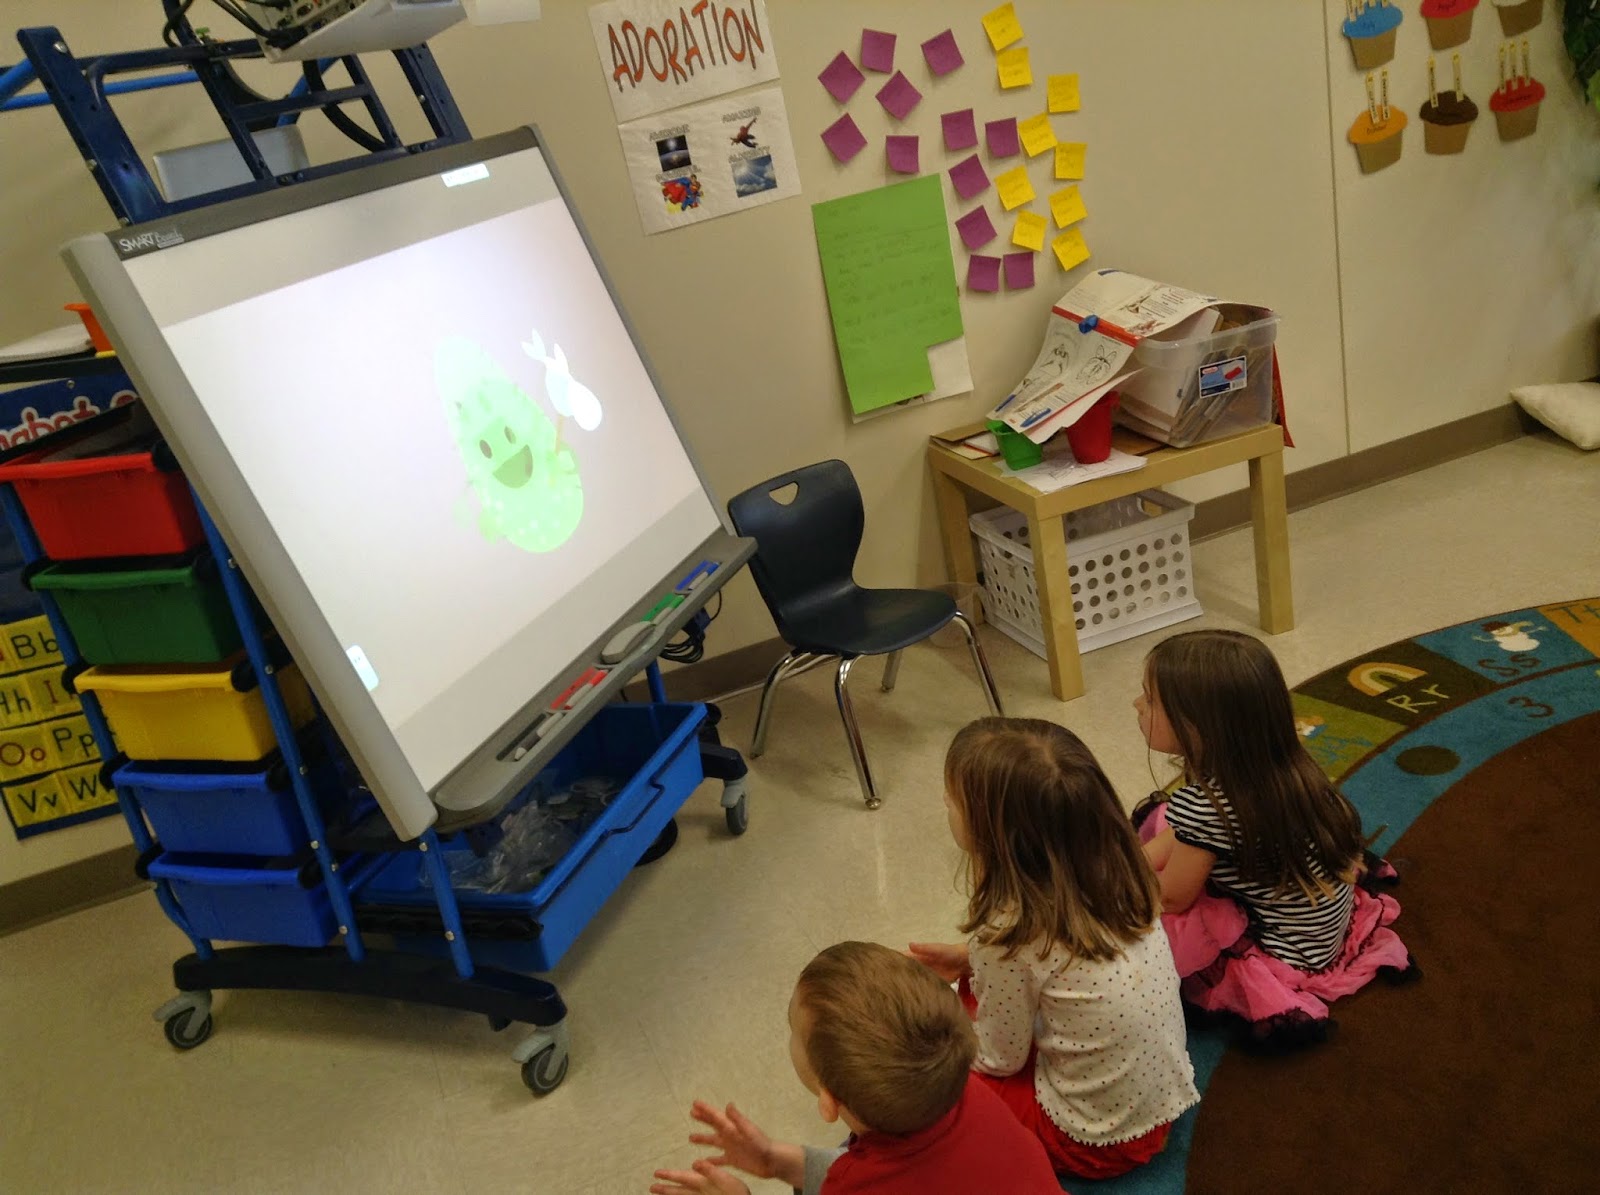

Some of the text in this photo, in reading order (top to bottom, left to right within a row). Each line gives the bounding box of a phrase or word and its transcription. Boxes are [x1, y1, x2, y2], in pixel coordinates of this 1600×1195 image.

[607, 0, 765, 93] ADORATION
[119, 232, 154, 252] SMART
[11, 631, 59, 660] Bb
[1478, 654, 1542, 678] Ss
[1386, 683, 1450, 714] Rr
[1507, 696, 1555, 719] 3
[0, 742, 46, 766] Oo
[52, 726, 96, 758] Pp
[18, 788, 58, 814] Vv
